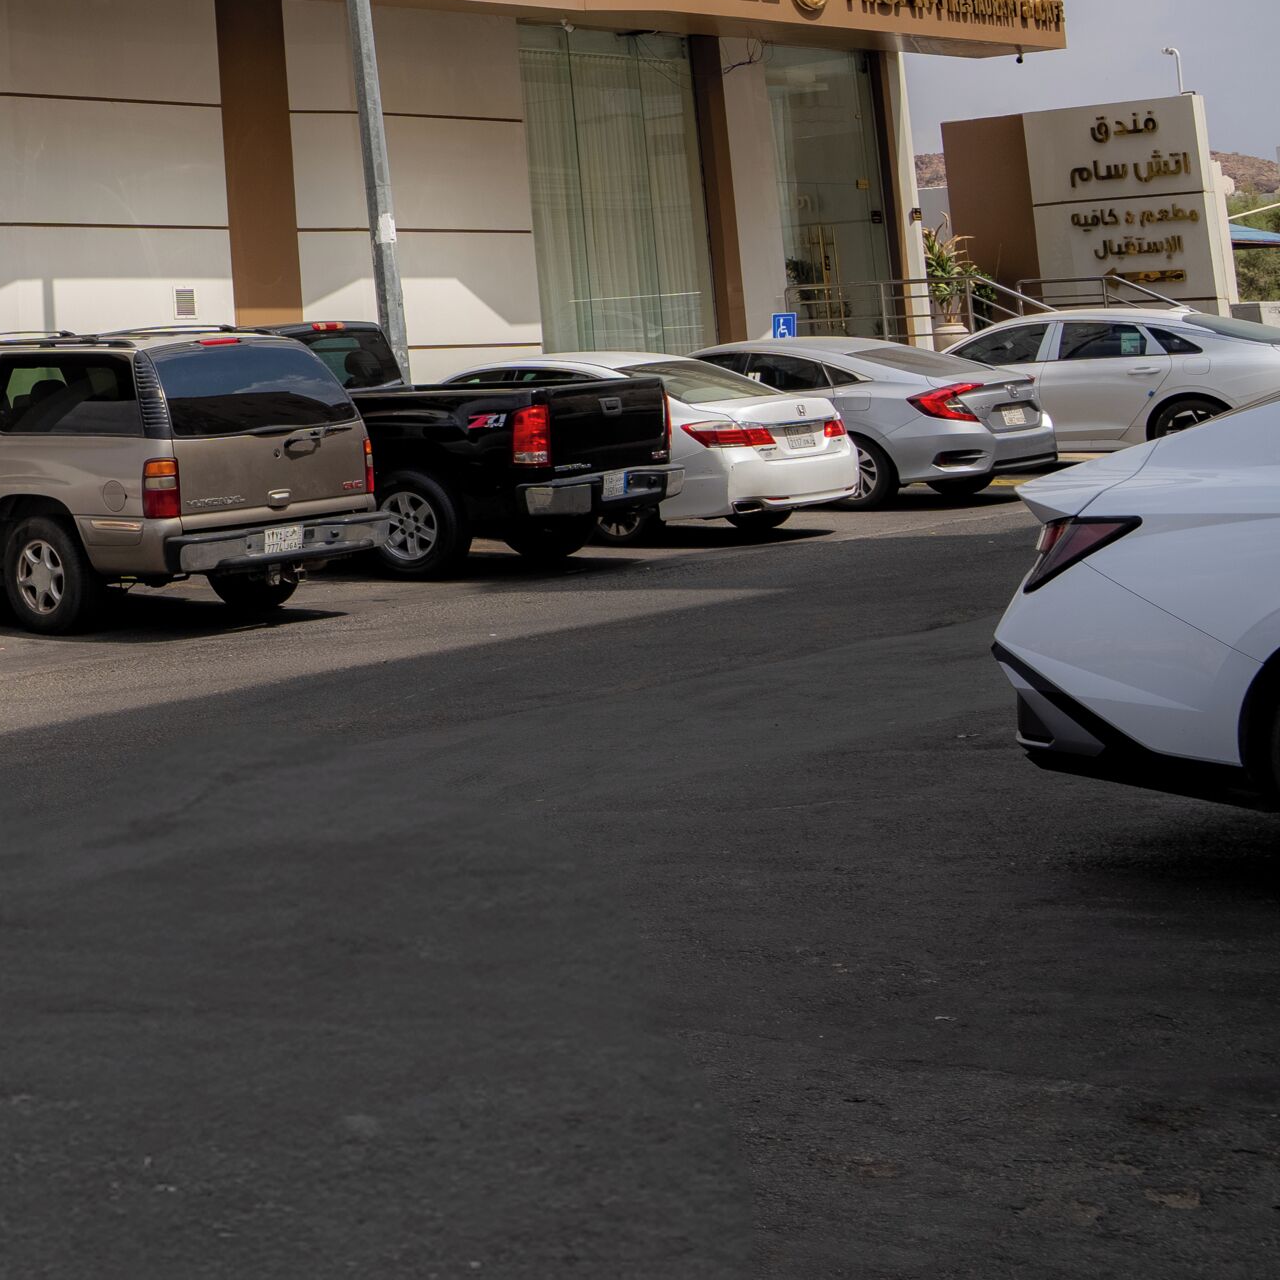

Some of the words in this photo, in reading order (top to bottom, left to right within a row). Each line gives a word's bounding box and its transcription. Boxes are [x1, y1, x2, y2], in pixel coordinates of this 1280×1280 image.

[1090, 110, 1158, 144] فندق
[1070, 160, 1128, 188] سام
[1133, 150, 1191, 183] اتش
[1070, 208, 1119, 232] كافيه
[1140, 203, 1199, 227] مطعم
